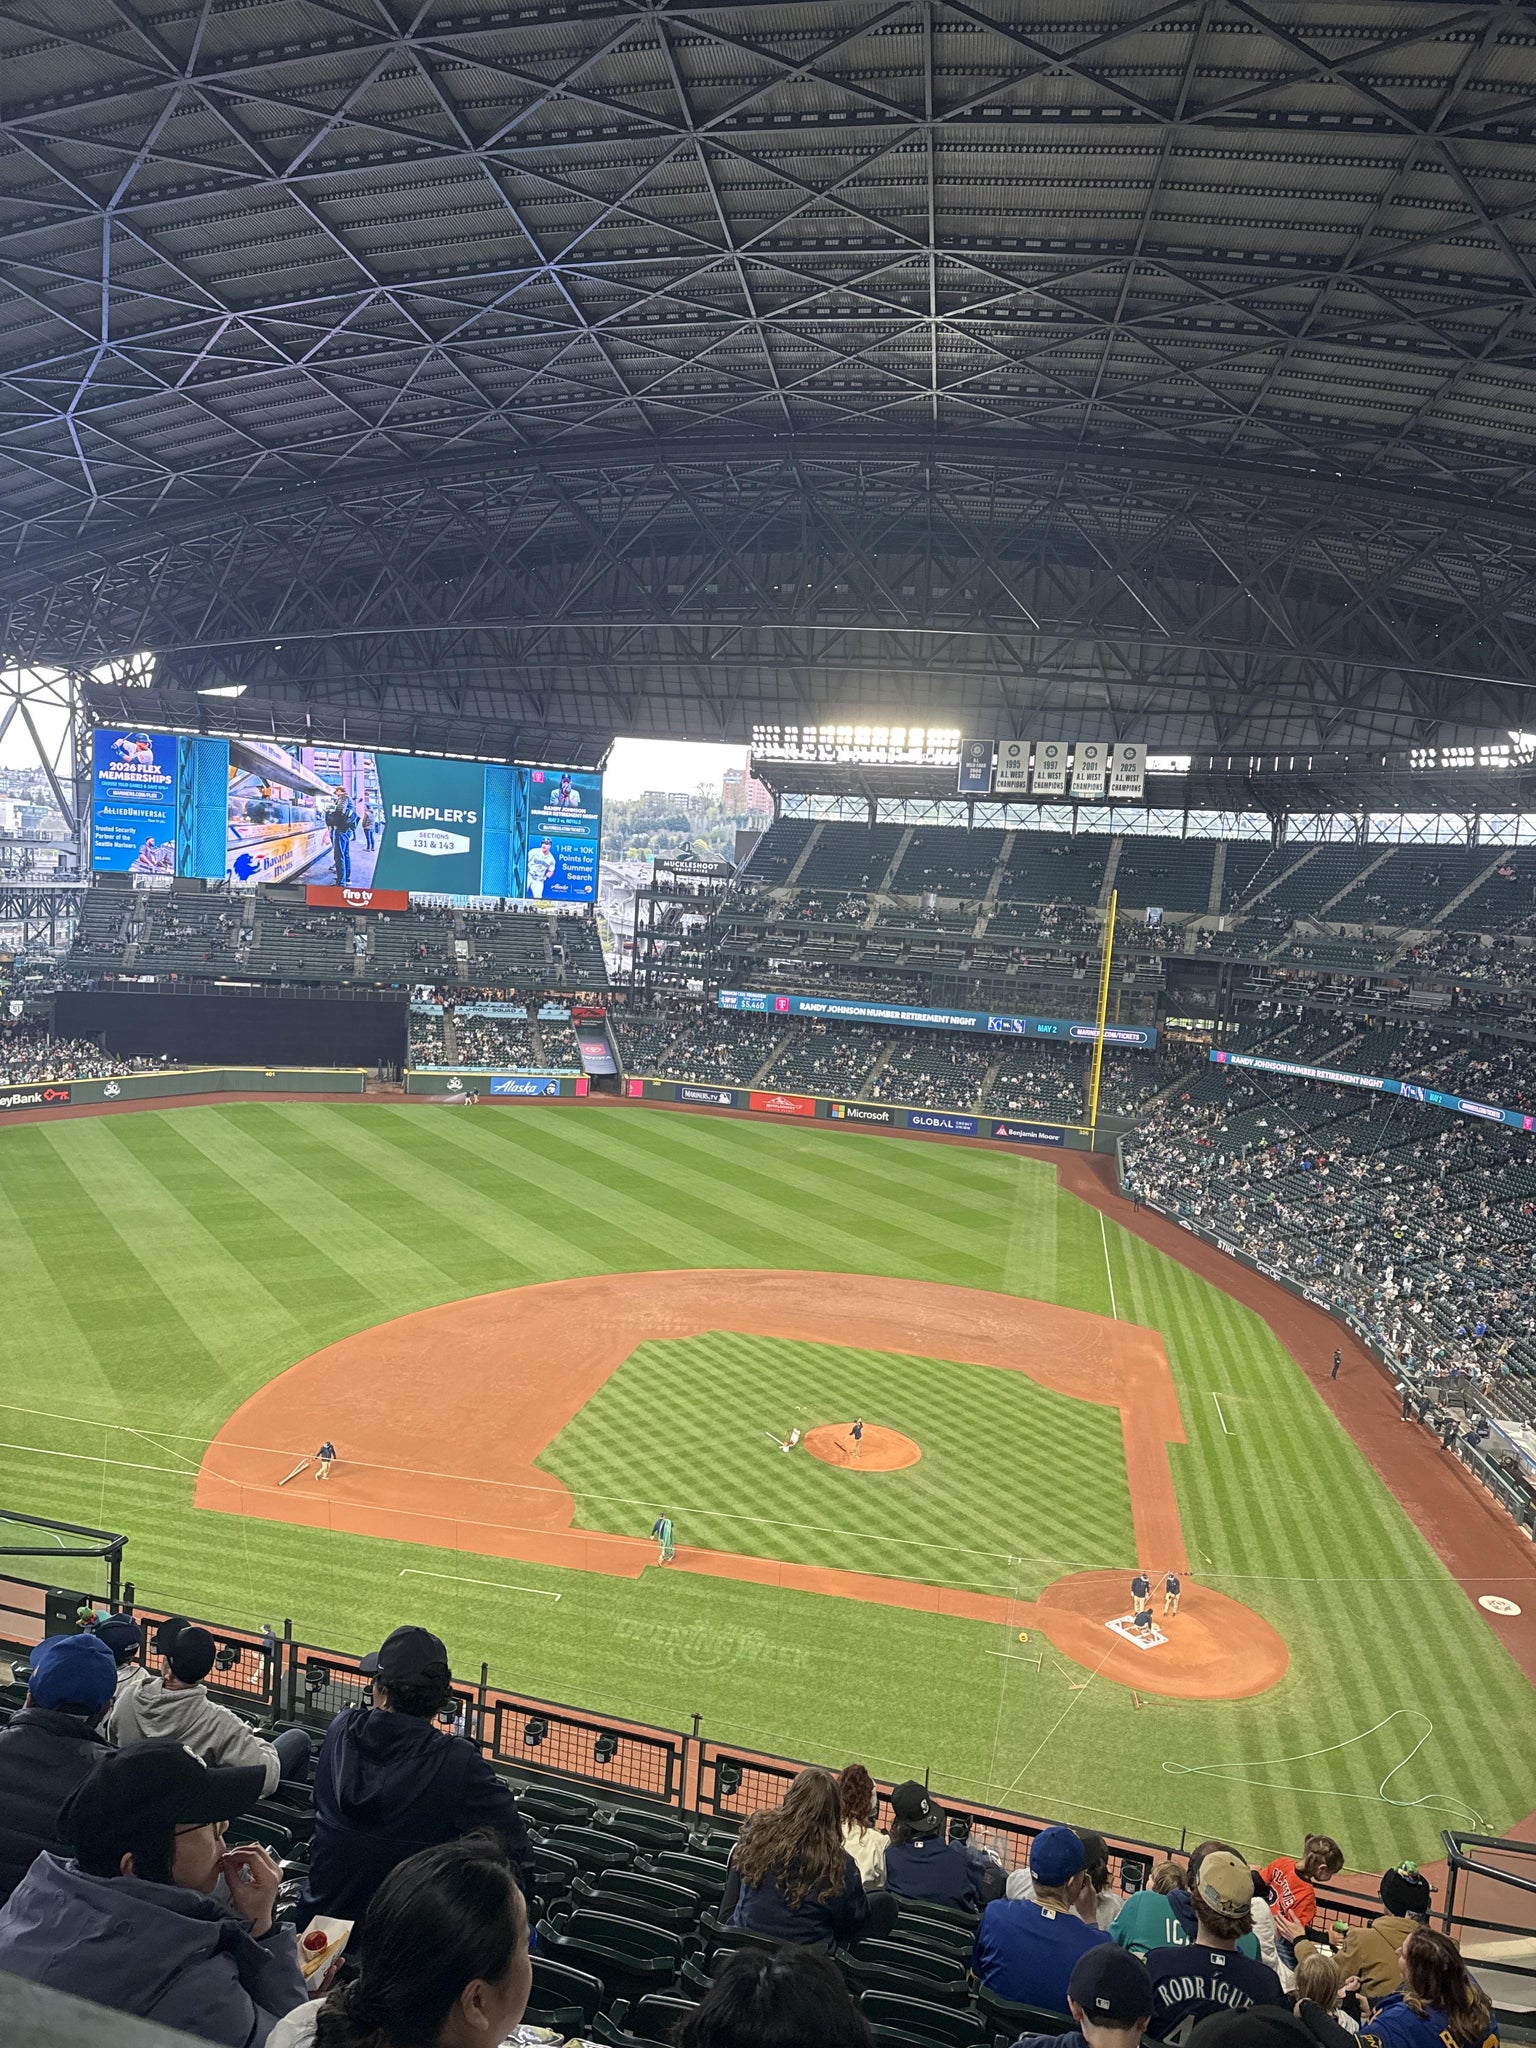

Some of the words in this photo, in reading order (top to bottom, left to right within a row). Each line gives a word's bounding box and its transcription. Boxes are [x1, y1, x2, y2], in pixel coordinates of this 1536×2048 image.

[110, 762, 136, 771] 2026
[138, 764, 161, 774] FLEX
[1006, 760, 1020, 768] 1995
[1044, 761, 1057, 769] 1997
[1082, 762, 1098, 770] 2001
[99, 770, 172, 784] MEMBERSHIPS
[1034, 782, 1064, 790] CHAMPIONS
[1073, 783, 1102, 791] CHAMPIONS
[392, 804, 477, 823] HEMPLER'S
[439, 841, 454, 850] 143
[264, 850, 293, 870] Bavarian
[559, 854, 581, 862] Points
[562, 863, 593, 872] Summer
[664, 860, 718, 870] MUCKLESHOOT
[567, 873, 592, 881] Search
[343, 889, 360, 900] fire
[362, 892, 373, 900] tv
[741, 1000, 764, 1009] $5,460
[800, 1003, 826, 1012] RANDY
[827, 1005, 866, 1016] JOHNSON
[867, 1009, 900, 1019] NUMBER
[901, 1013, 950, 1024] RETIREMENT
[951, 1016, 976, 1026] NIGHT
[1077, 1029, 1139, 1041] MARINER.COM/TICKETS
[1231, 1055, 1254, 1066] RANDY
[1254, 1059, 1286, 1071] JOHNSON
[1287, 1065, 1316, 1077] NUMBER
[1316, 1070, 1360, 1083] RETIREMENT
[1360, 1077, 1383, 1088] NIGHT
[108, 1084, 118, 1092] 50
[494, 1080, 538, 1093] Alaska
[0, 1092, 42, 1107] eyBank
[847, 1108, 890, 1121] Microsoft
[912, 1116, 953, 1129] GLOBAL
[1008, 1128, 1037, 1138] Benjamin
[1039, 1132, 1058, 1140] Moore
[1217, 1240, 1236, 1257] STIHL
[1310, 1294, 1330, 1310] LEXUS
[921, 1799, 929, 1814] S
